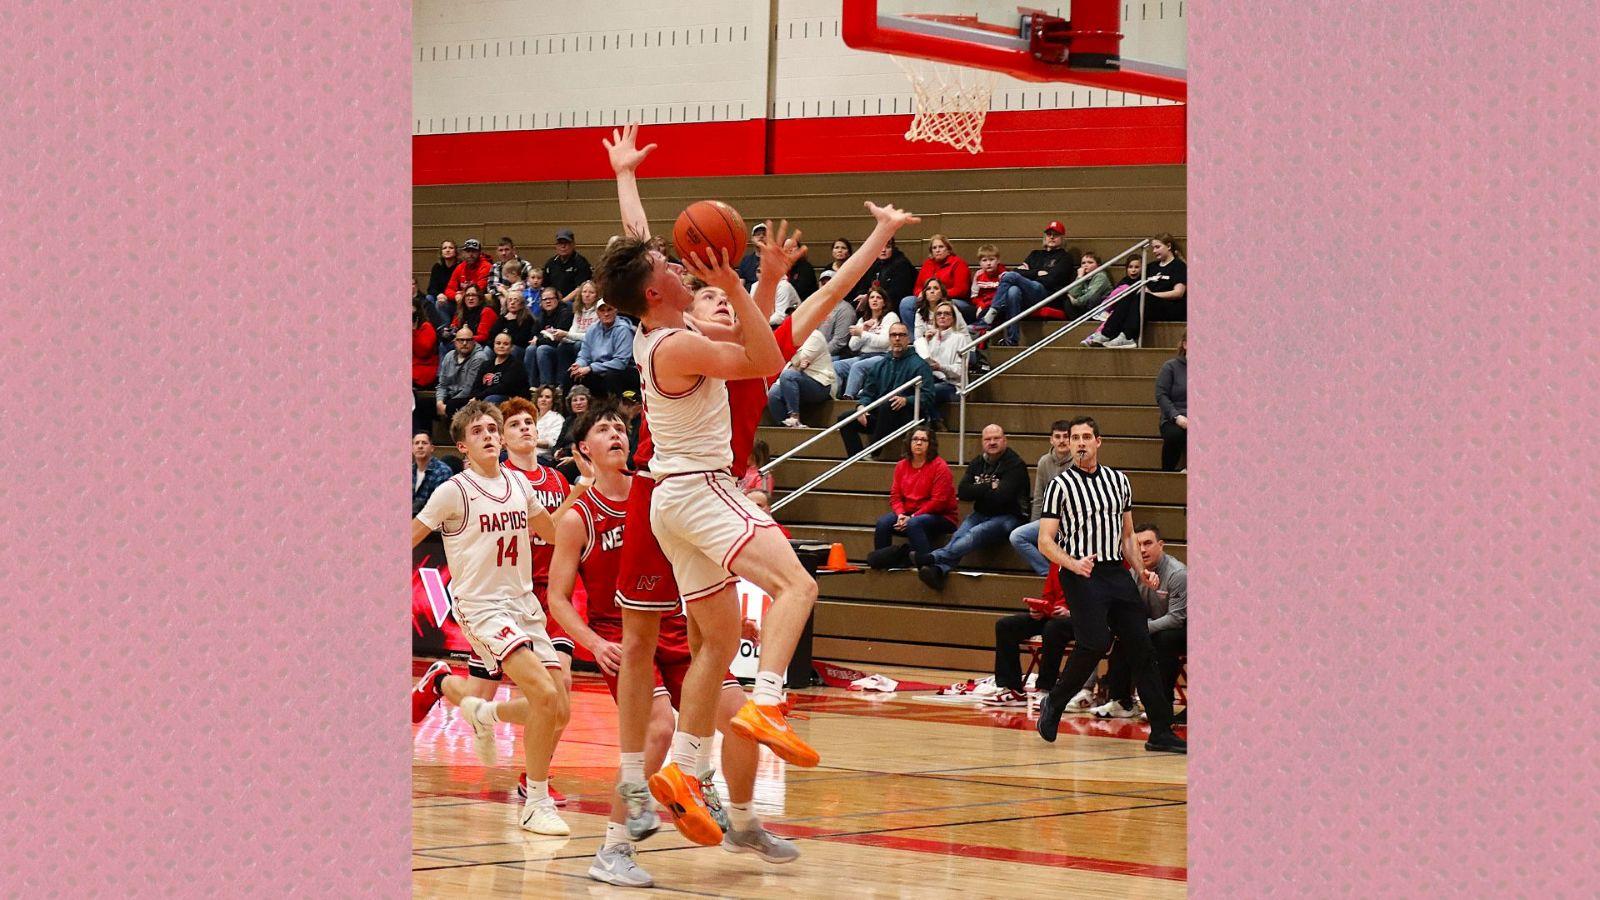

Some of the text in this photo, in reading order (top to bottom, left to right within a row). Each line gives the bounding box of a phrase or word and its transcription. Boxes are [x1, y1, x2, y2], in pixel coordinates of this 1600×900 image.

[535, 490, 563, 507] NAH
[479, 511, 527, 533] RAPIDS
[601, 524, 626, 551] NE
[496, 535, 518, 567] 14
